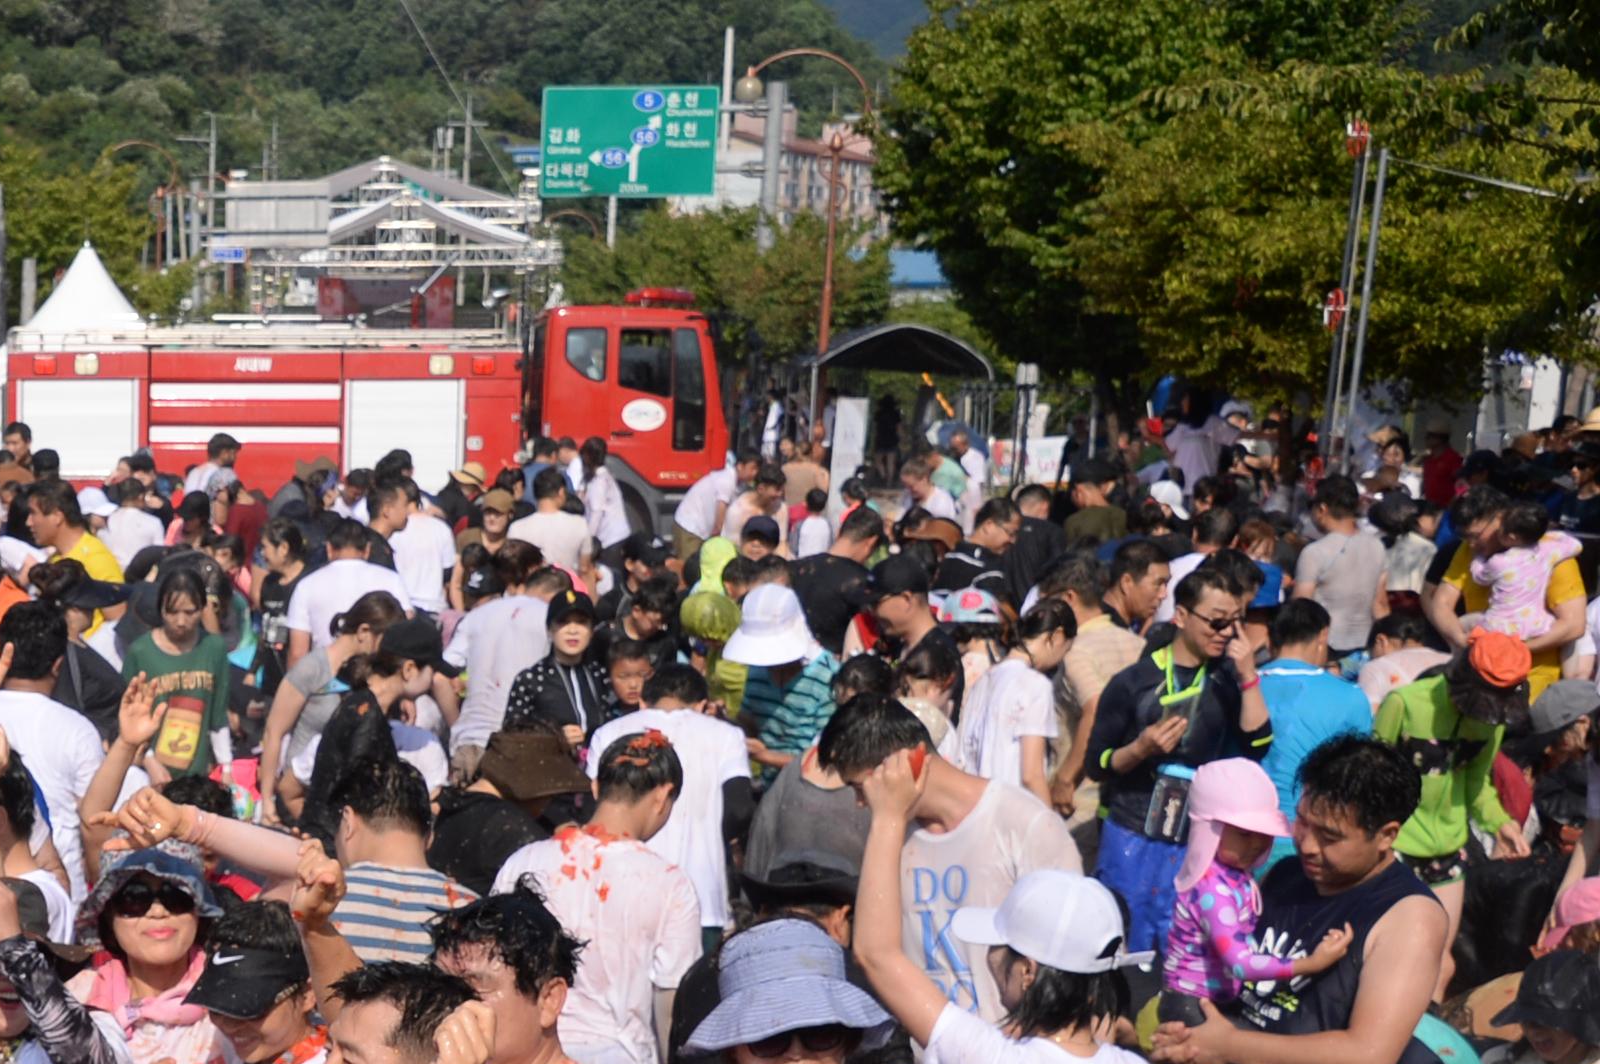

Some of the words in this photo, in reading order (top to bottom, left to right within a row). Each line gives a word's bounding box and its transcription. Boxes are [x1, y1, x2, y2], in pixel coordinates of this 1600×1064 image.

[643, 93, 654, 108] 5
[635, 130, 654, 144] 56
[604, 152, 622, 165] 56
[913, 864, 970, 904] DO
